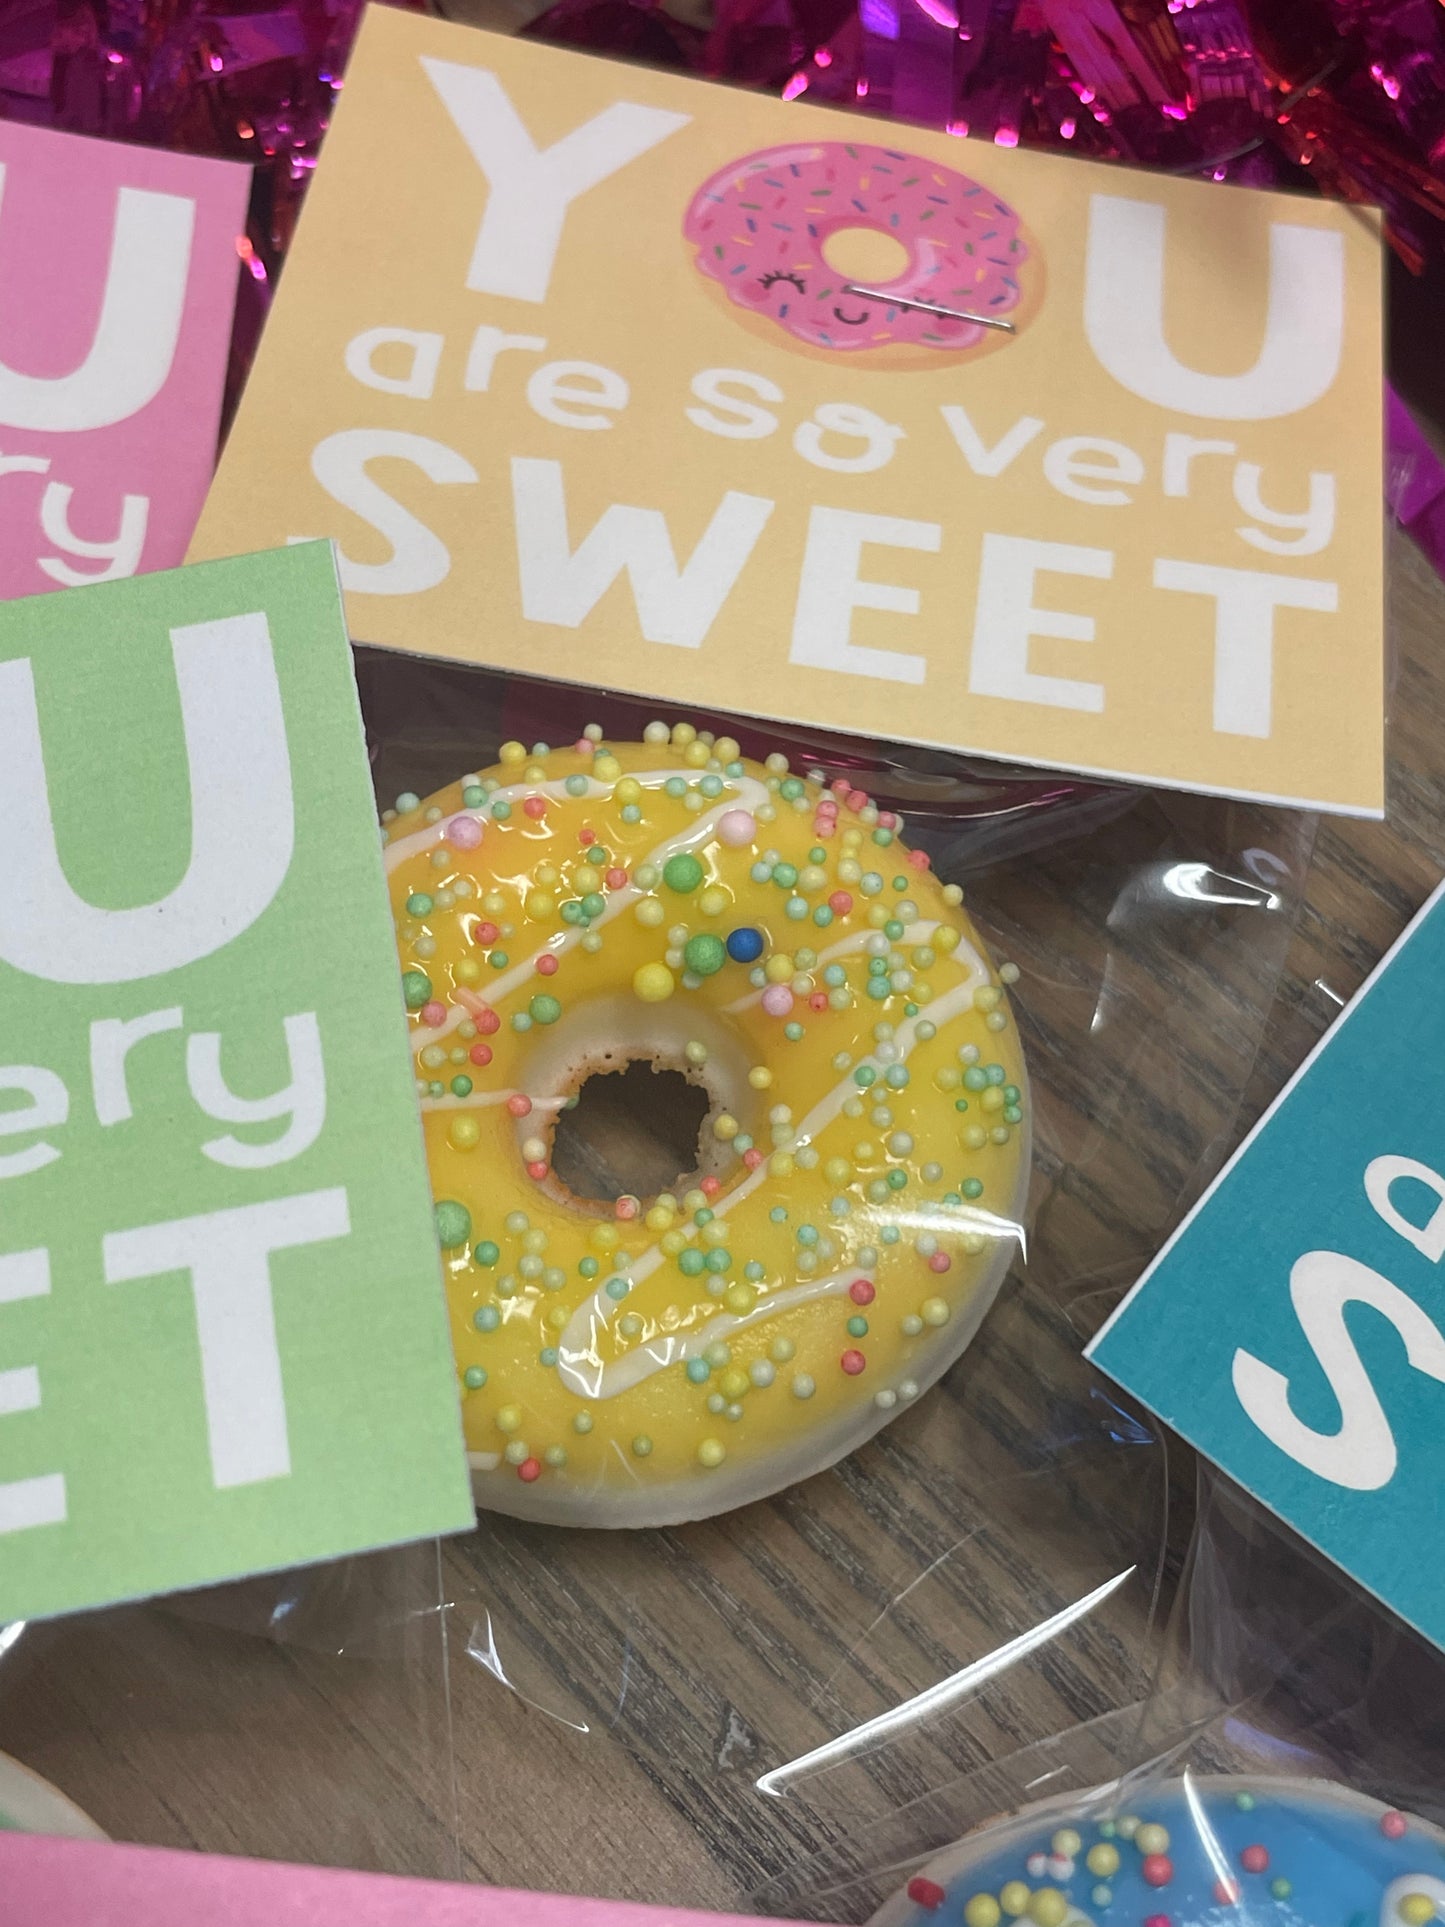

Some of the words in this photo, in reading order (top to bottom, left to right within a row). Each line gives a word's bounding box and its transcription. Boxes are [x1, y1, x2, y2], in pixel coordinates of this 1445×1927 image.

[344, 326, 630, 430] are
[686, 367, 907, 473] so
[941, 404, 1336, 556] very
[287, 428, 1339, 740] SWEET
